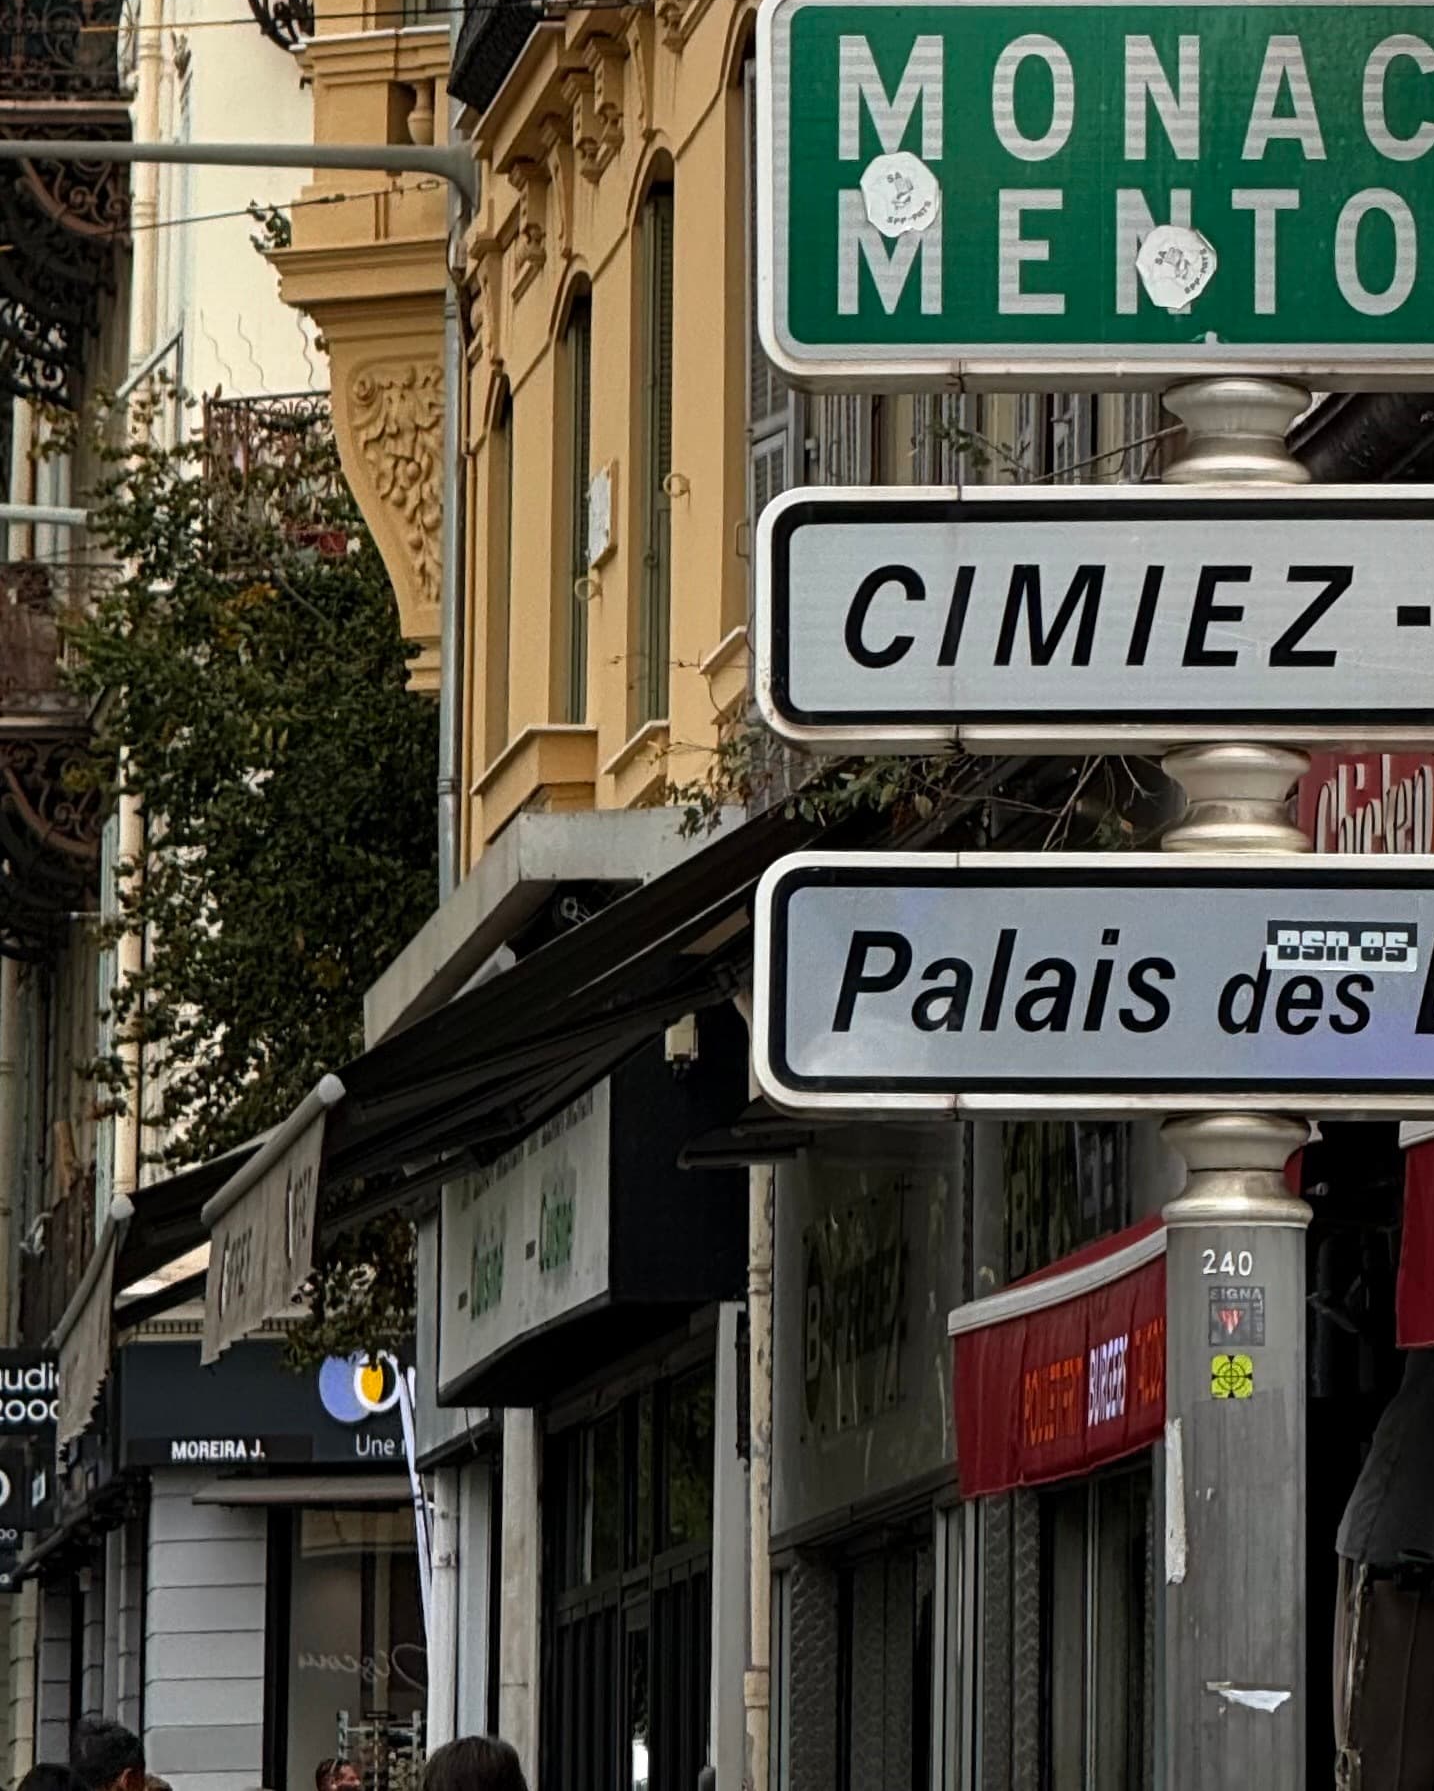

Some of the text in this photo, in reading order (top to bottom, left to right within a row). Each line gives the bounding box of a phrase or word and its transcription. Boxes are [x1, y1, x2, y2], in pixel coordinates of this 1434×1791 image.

[844, 564, 1354, 669] CIMIEZ
[831, 928, 1176, 1033] Palais
[1217, 950, 1374, 1036] des
[1202, 1249, 1252, 1276] 240
[0, 1362, 60, 1392] udi
[1087, 1333, 1129, 1427] BURGERS
[171, 1439, 266, 1460] MOREIRA J.
[356, 1433, 396, 1457] Une
